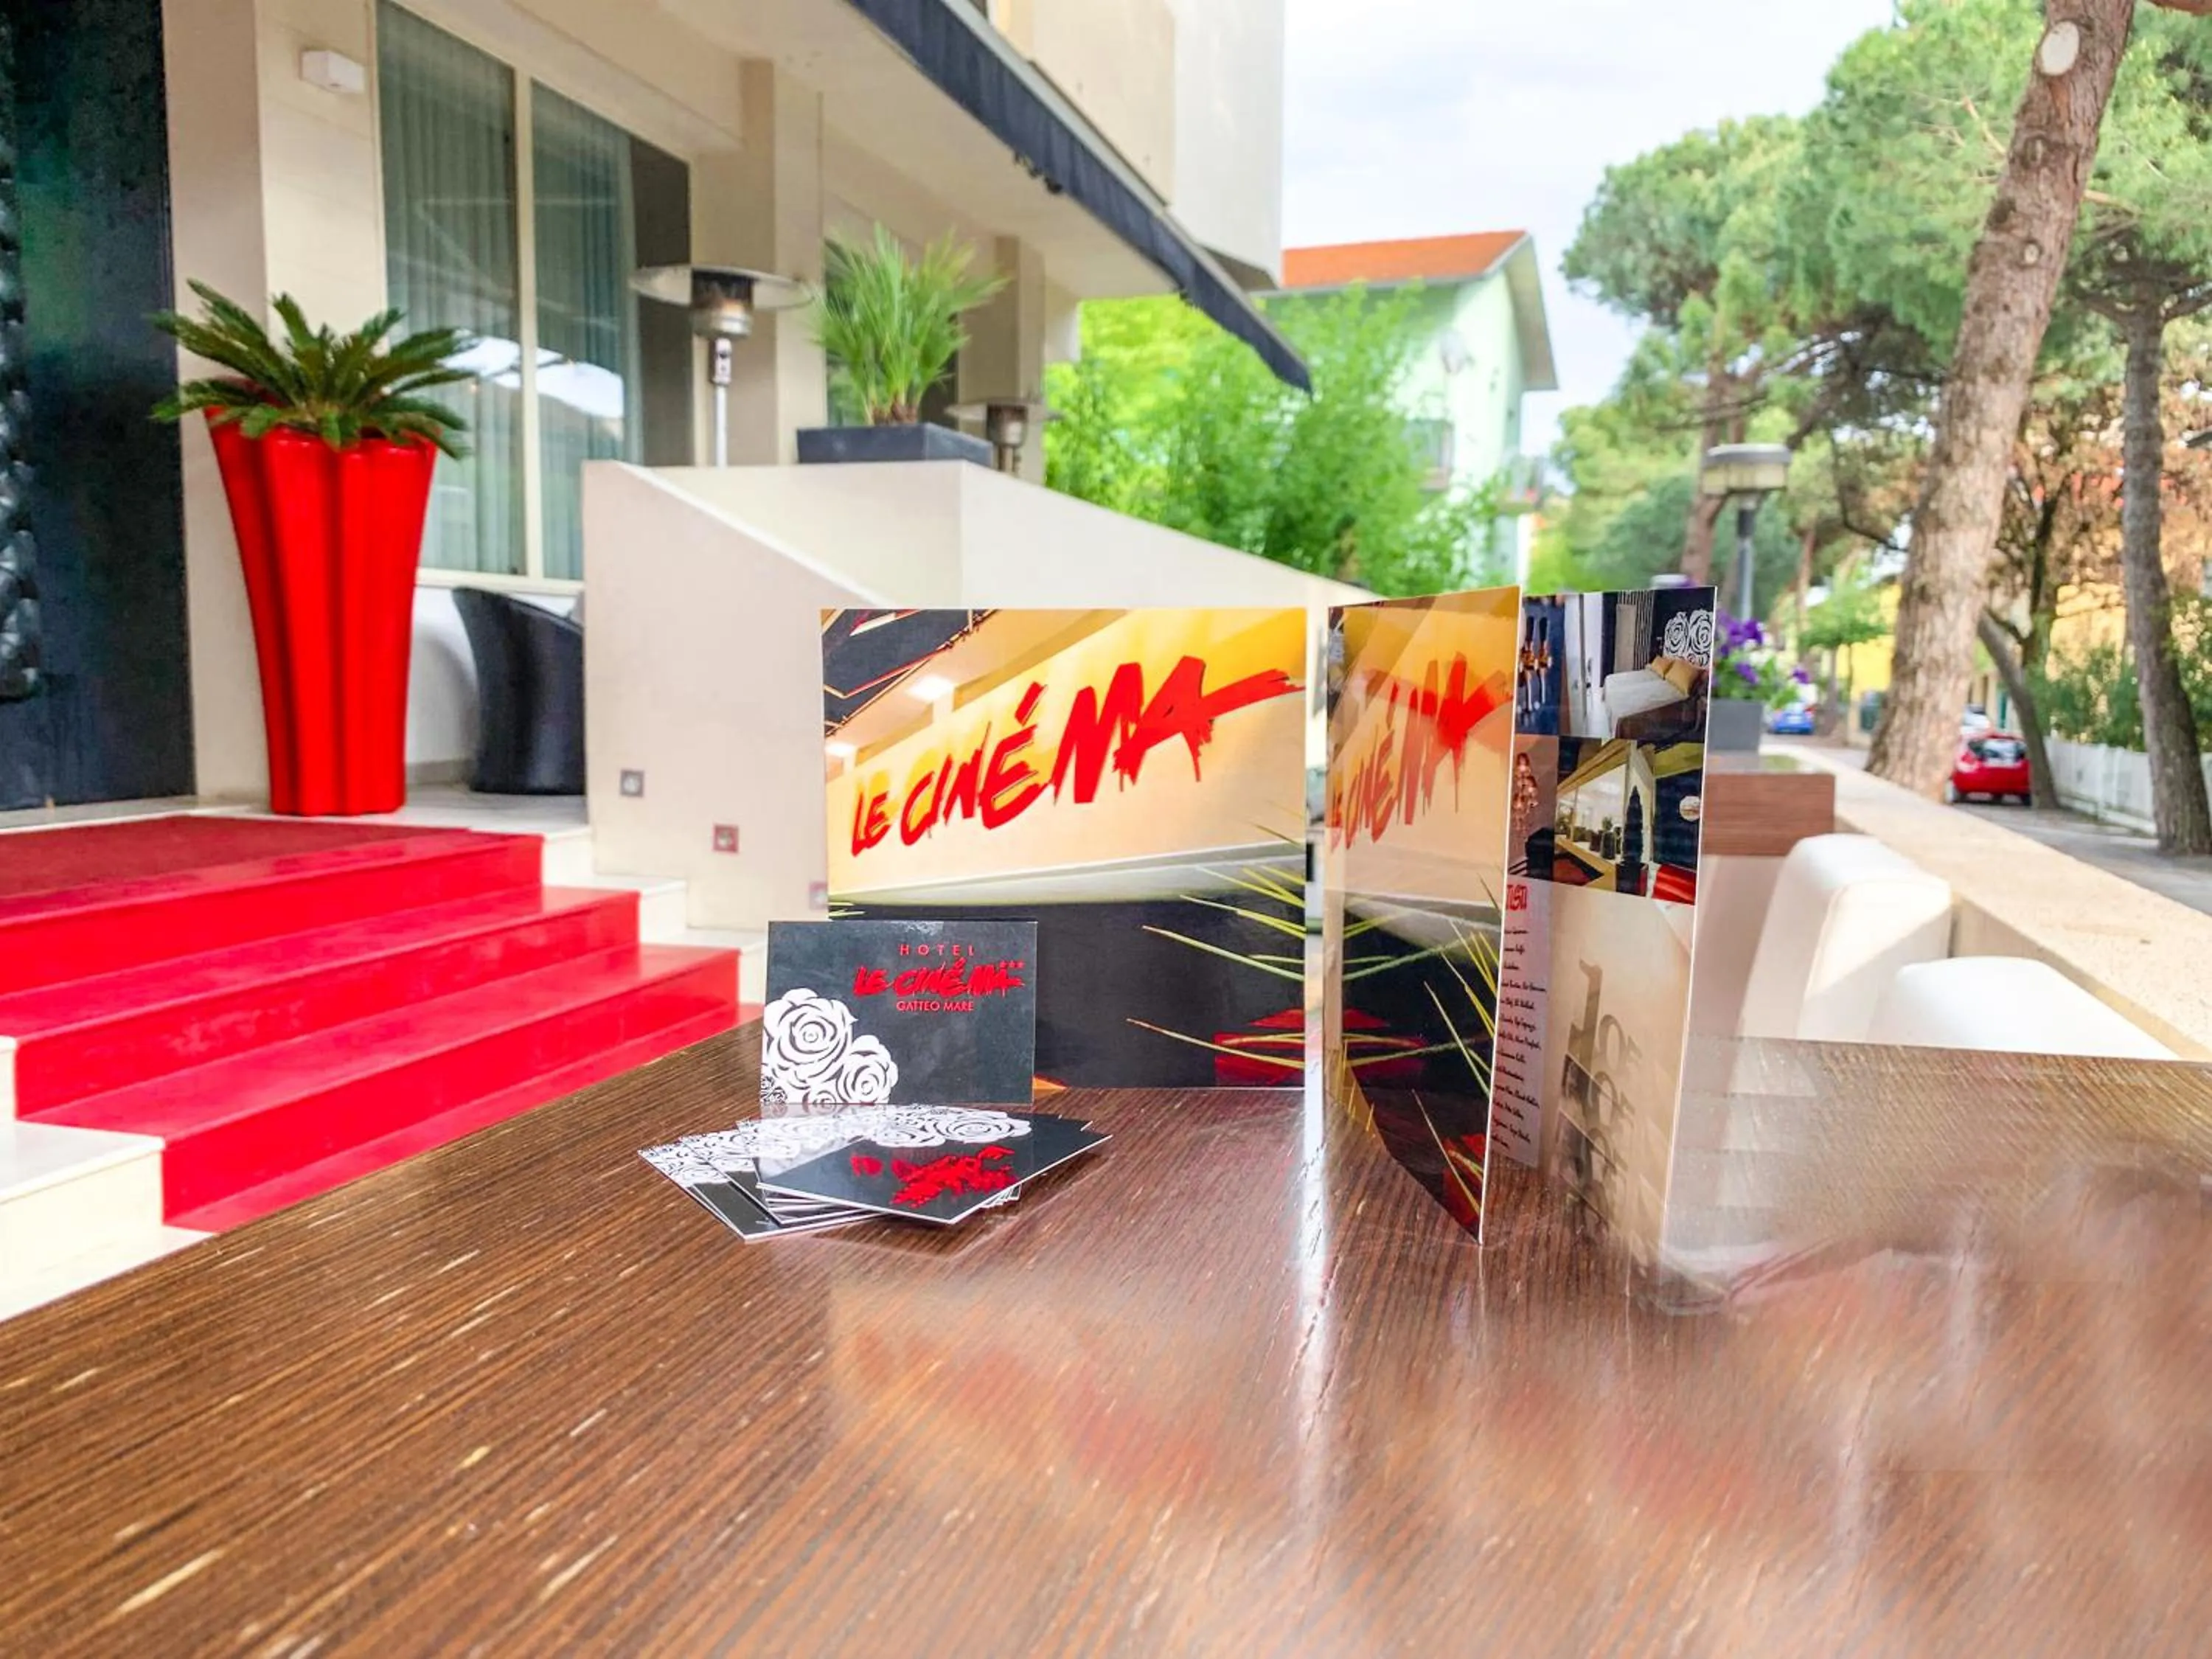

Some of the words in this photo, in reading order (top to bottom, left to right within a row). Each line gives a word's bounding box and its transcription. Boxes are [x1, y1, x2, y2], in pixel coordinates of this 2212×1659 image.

[851, 790, 892, 857] LE
[900, 655, 1306, 846] CINÉMA
[899, 943, 975, 956] HOTEL
[852, 964, 889, 997] LE
[895, 1000, 941, 1012] GATTEO
[942, 1000, 975, 1013] MARE
